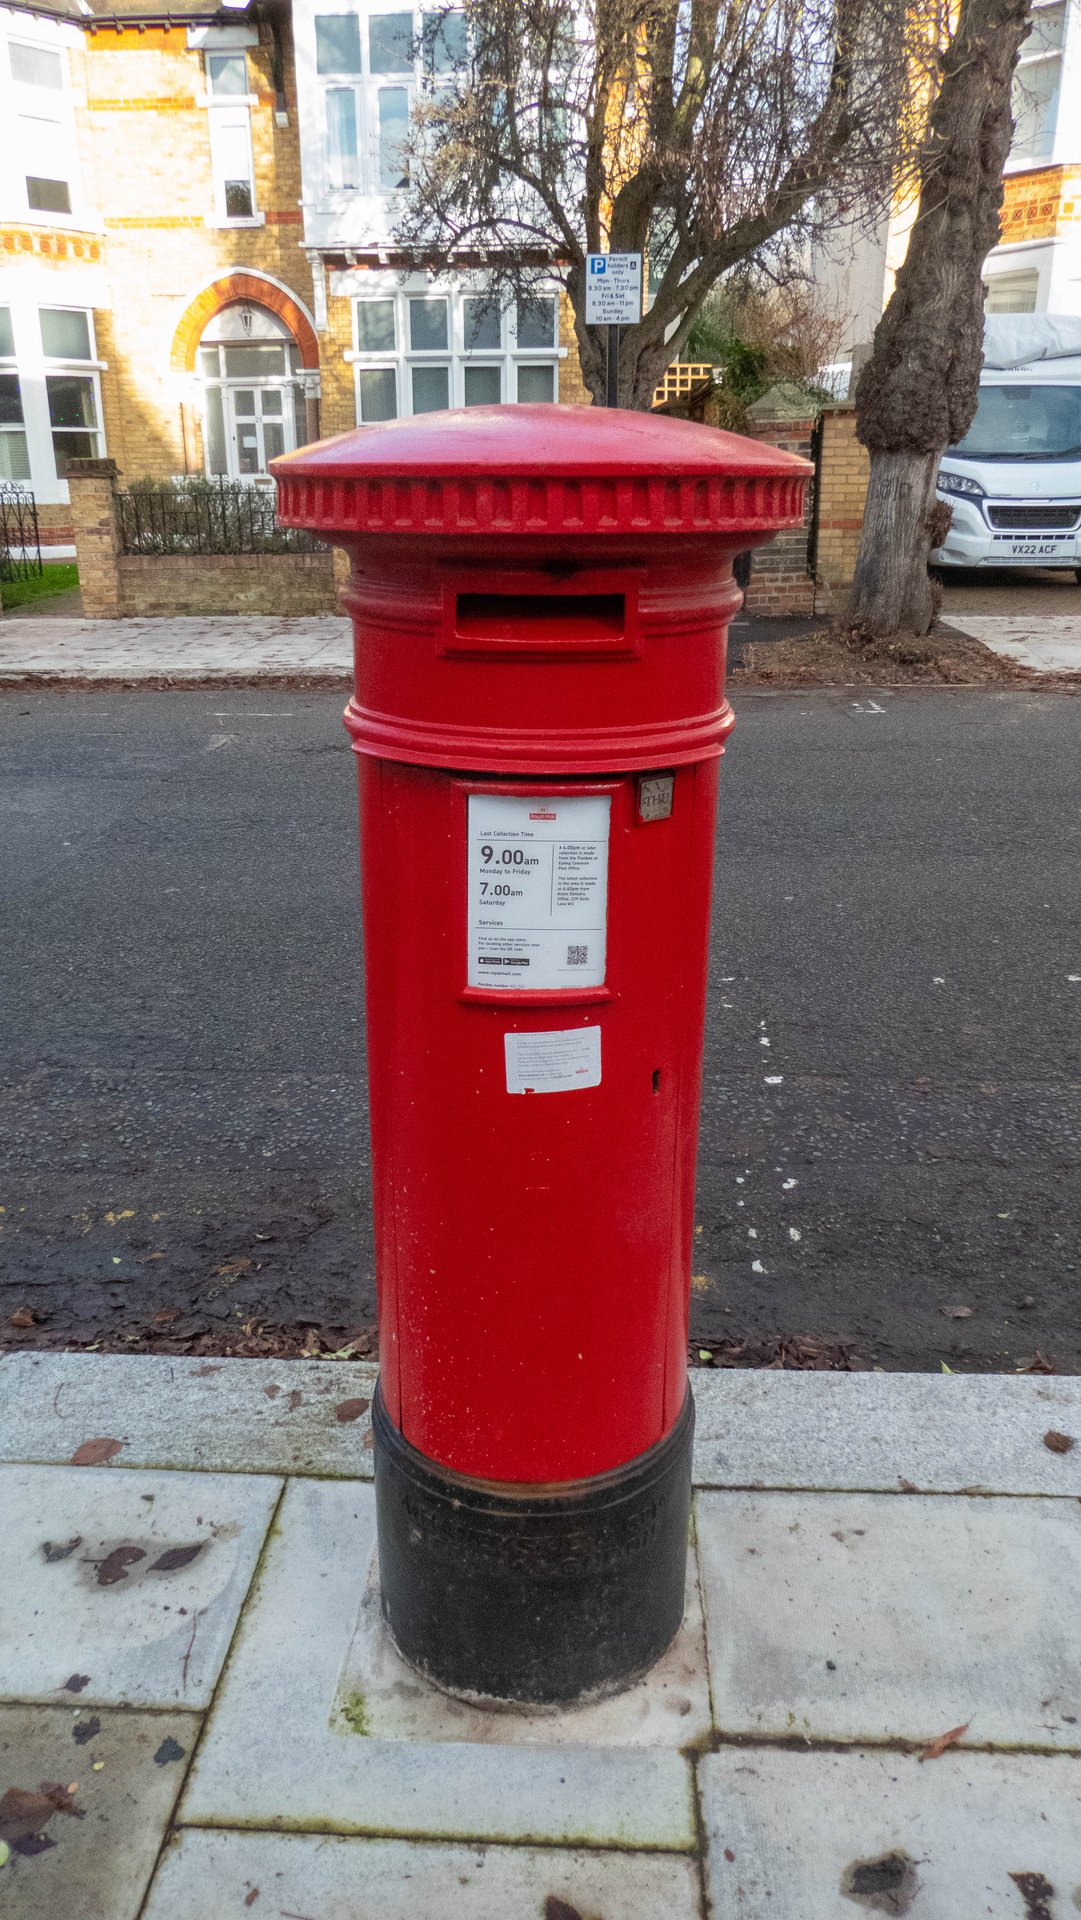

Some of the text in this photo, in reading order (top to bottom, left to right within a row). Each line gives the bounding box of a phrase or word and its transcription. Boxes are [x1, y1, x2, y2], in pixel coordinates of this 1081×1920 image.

[594, 260, 604, 273] P
[1012, 545, 1057, 554] VX22 ACF
[645, 792, 670, 806] THU
[481, 845, 539, 865] 9.00am
[480, 882, 523, 896] 7.00am
